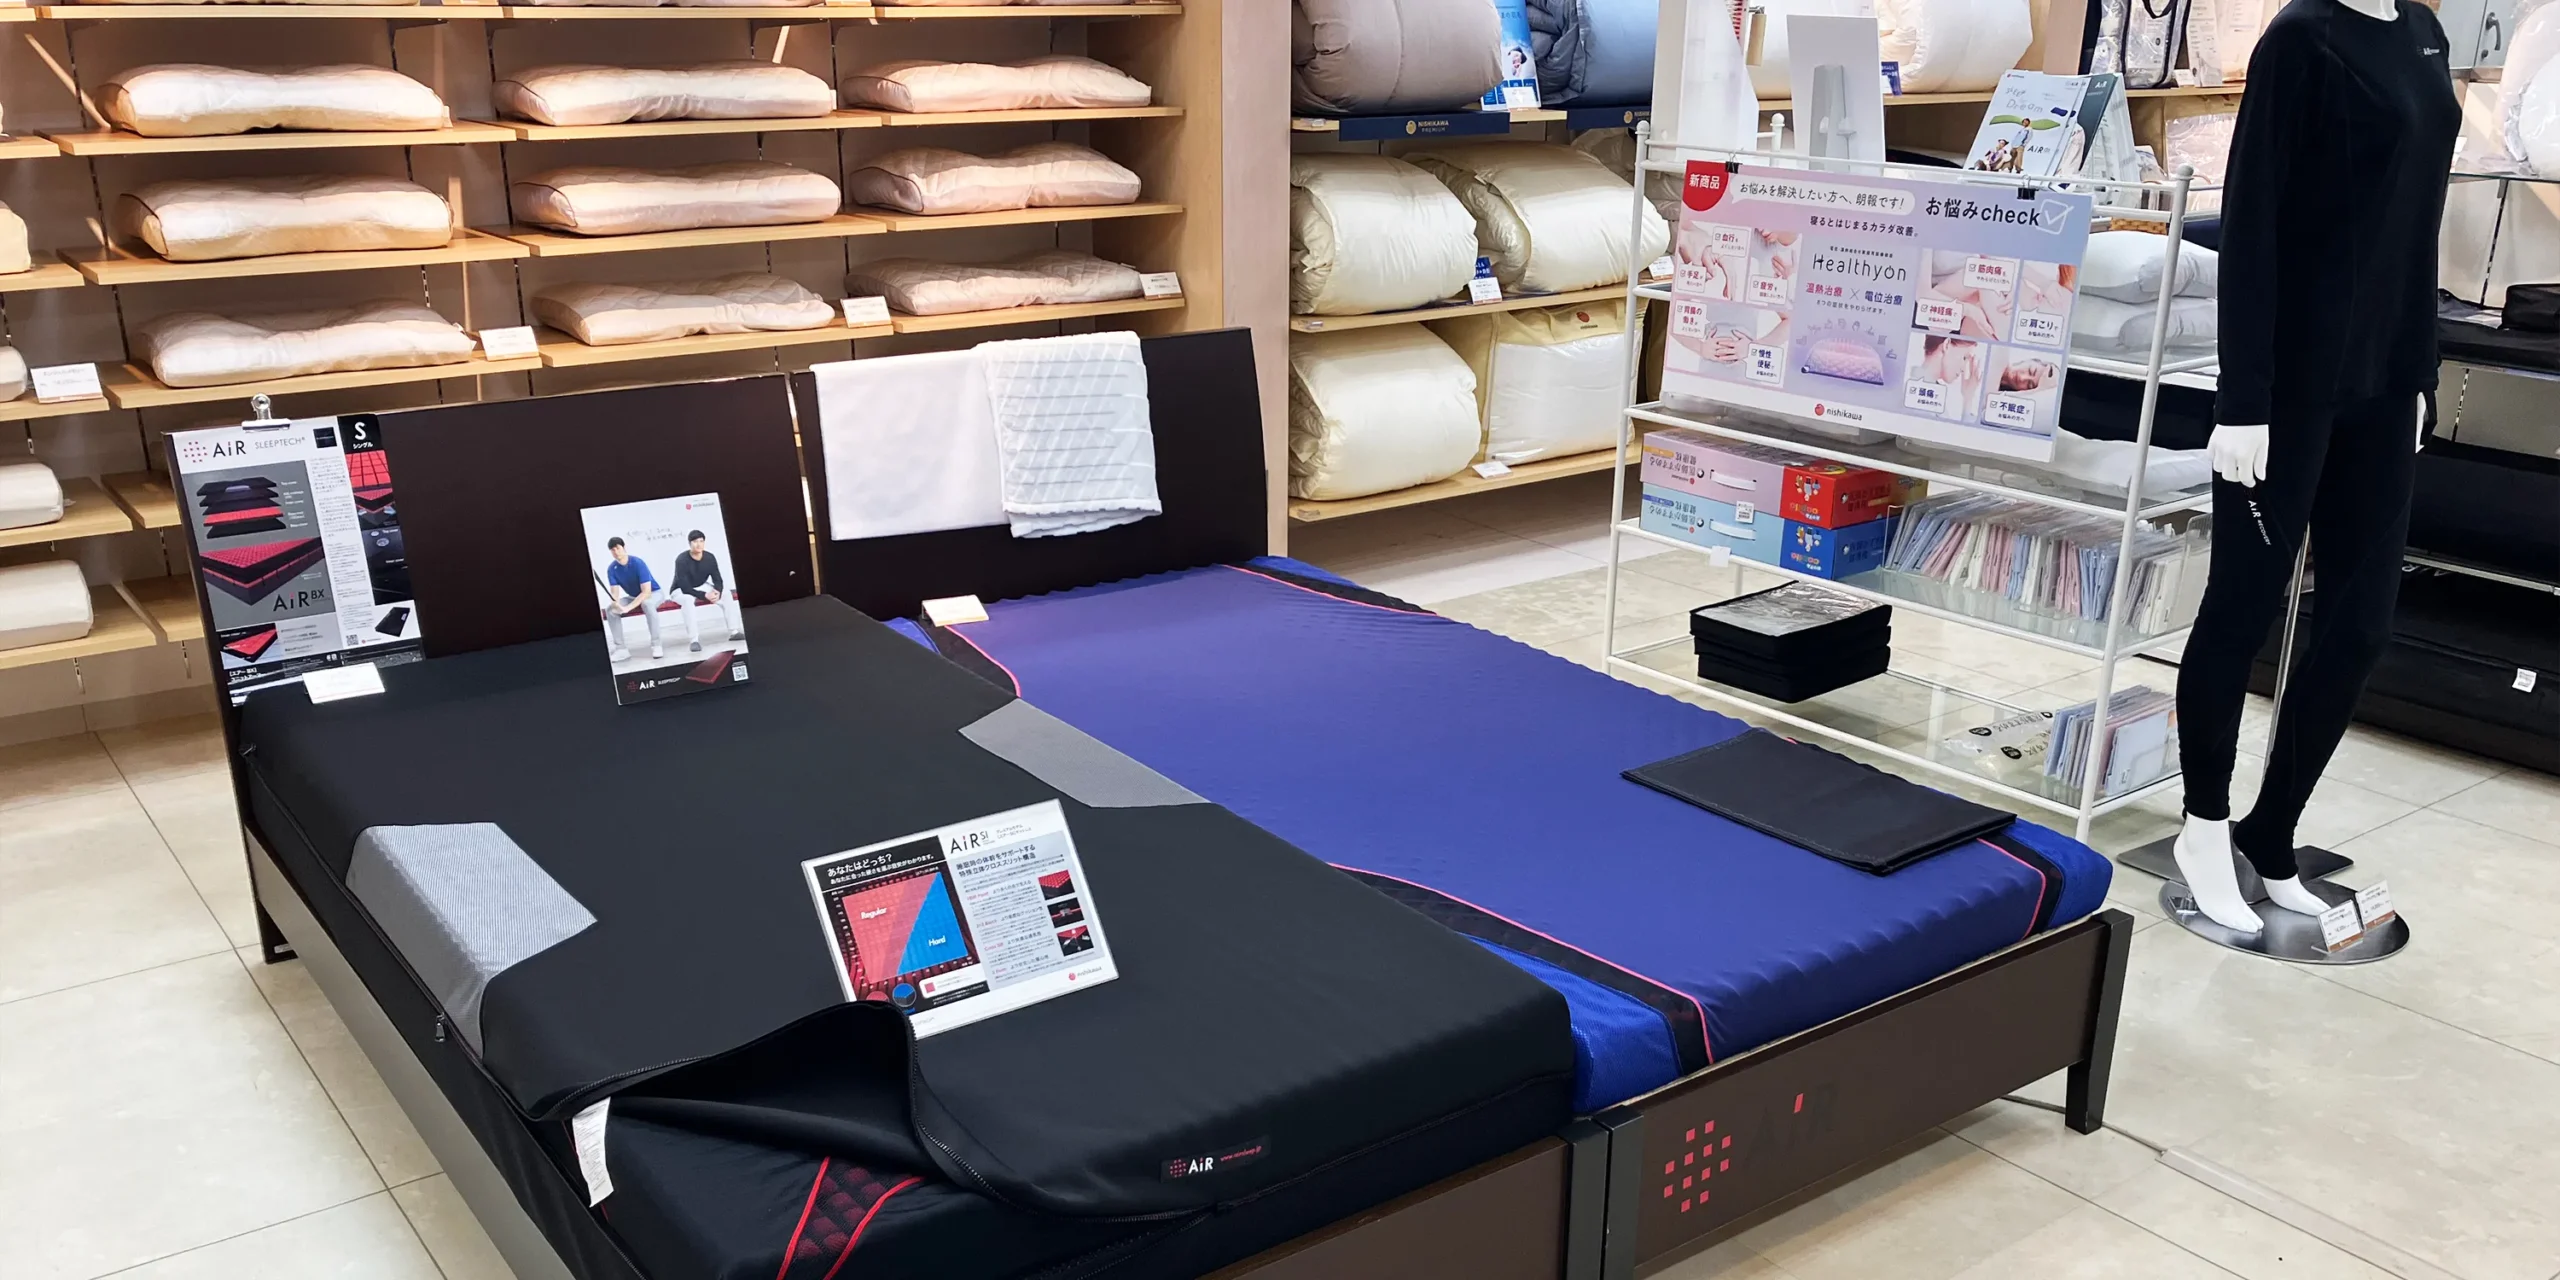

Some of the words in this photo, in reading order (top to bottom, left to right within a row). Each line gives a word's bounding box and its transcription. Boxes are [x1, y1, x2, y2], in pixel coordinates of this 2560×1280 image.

[1688, 173, 1720, 190] 新商品
[1813, 253, 1906, 282] Healthyon
[1806, 282, 1843, 297] 温熱治療
[1864, 290, 1904, 306] 電位治療
[1826, 407, 1863, 421] nishikawa
[355, 422, 367, 441] S
[213, 440, 247, 458] AiR
[353, 442, 373, 450] シングル
[273, 591, 310, 611] AiR
[311, 589, 325, 600] BX
[639, 680, 656, 691] AiR
[950, 833, 981, 854] AiR
[861, 907, 888, 919] Regular
[928, 935, 946, 947] Hard
[1188, 1157, 1214, 1175] AiR
